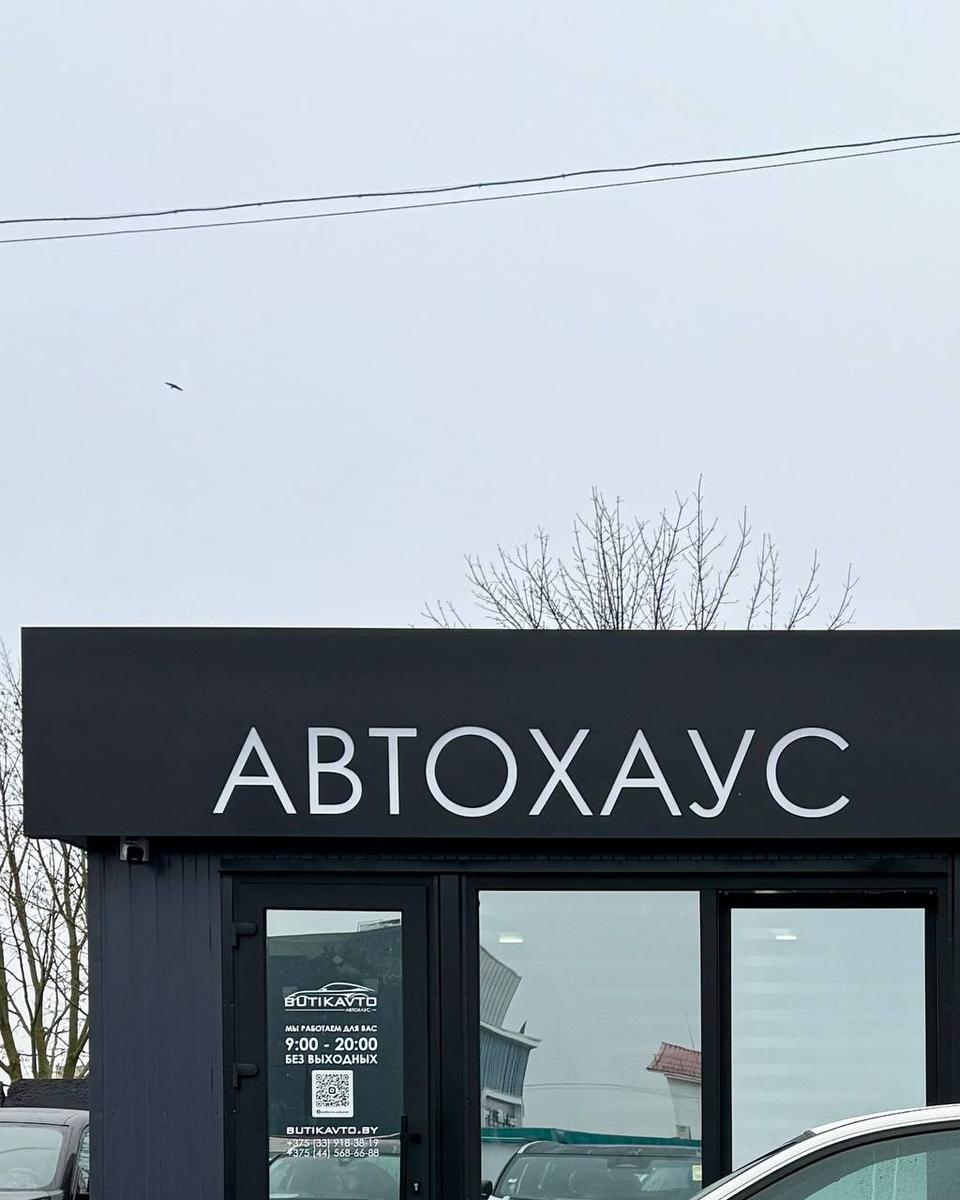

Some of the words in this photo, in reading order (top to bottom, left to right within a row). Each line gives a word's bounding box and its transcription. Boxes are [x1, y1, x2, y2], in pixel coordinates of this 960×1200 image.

[212, 726, 850, 819] АВТОХАУС
[284, 996, 377, 1007] BUTIKAVTO
[343, 1025, 359, 1033] ДЛЯ
[285, 1037, 319, 1051] 9:00
[334, 1037, 378, 1051] 20:00
[285, 1054, 304, 1064] БЕЗ
[308, 1054, 378, 1065] ВЫХОДНЫХ
[286, 1126, 379, 1135] BUTIKAVTO.BY
[287, 1138, 310, 1148] +375
[313, 1138, 330, 1149] (33)
[333, 1138, 379, 1148] 918-38-19
[313, 1148, 330, 1159] (44)
[333, 1148, 379, 1158] 568-66-88
